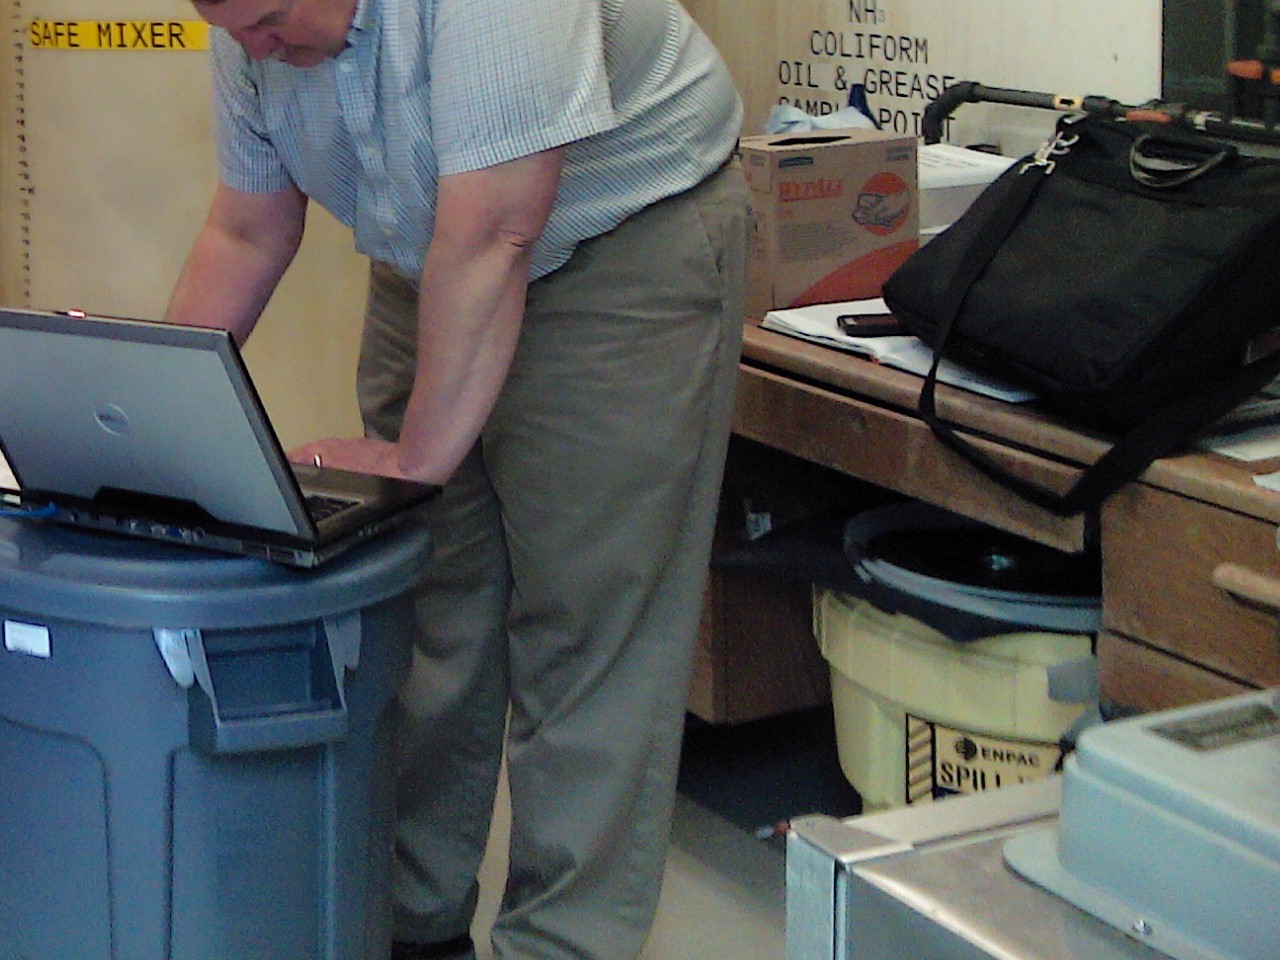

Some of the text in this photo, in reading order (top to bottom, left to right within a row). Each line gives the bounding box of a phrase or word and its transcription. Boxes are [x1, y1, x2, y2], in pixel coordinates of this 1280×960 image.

[31, 21, 186, 48] SAFE MIXER
[810, 29, 929, 65] COLIFORM
[778, 60, 819, 90] OIL
[834, 65, 848, 91] &
[880, 108, 956, 143] POIT
[981, 746, 1040, 769] ENPAC
